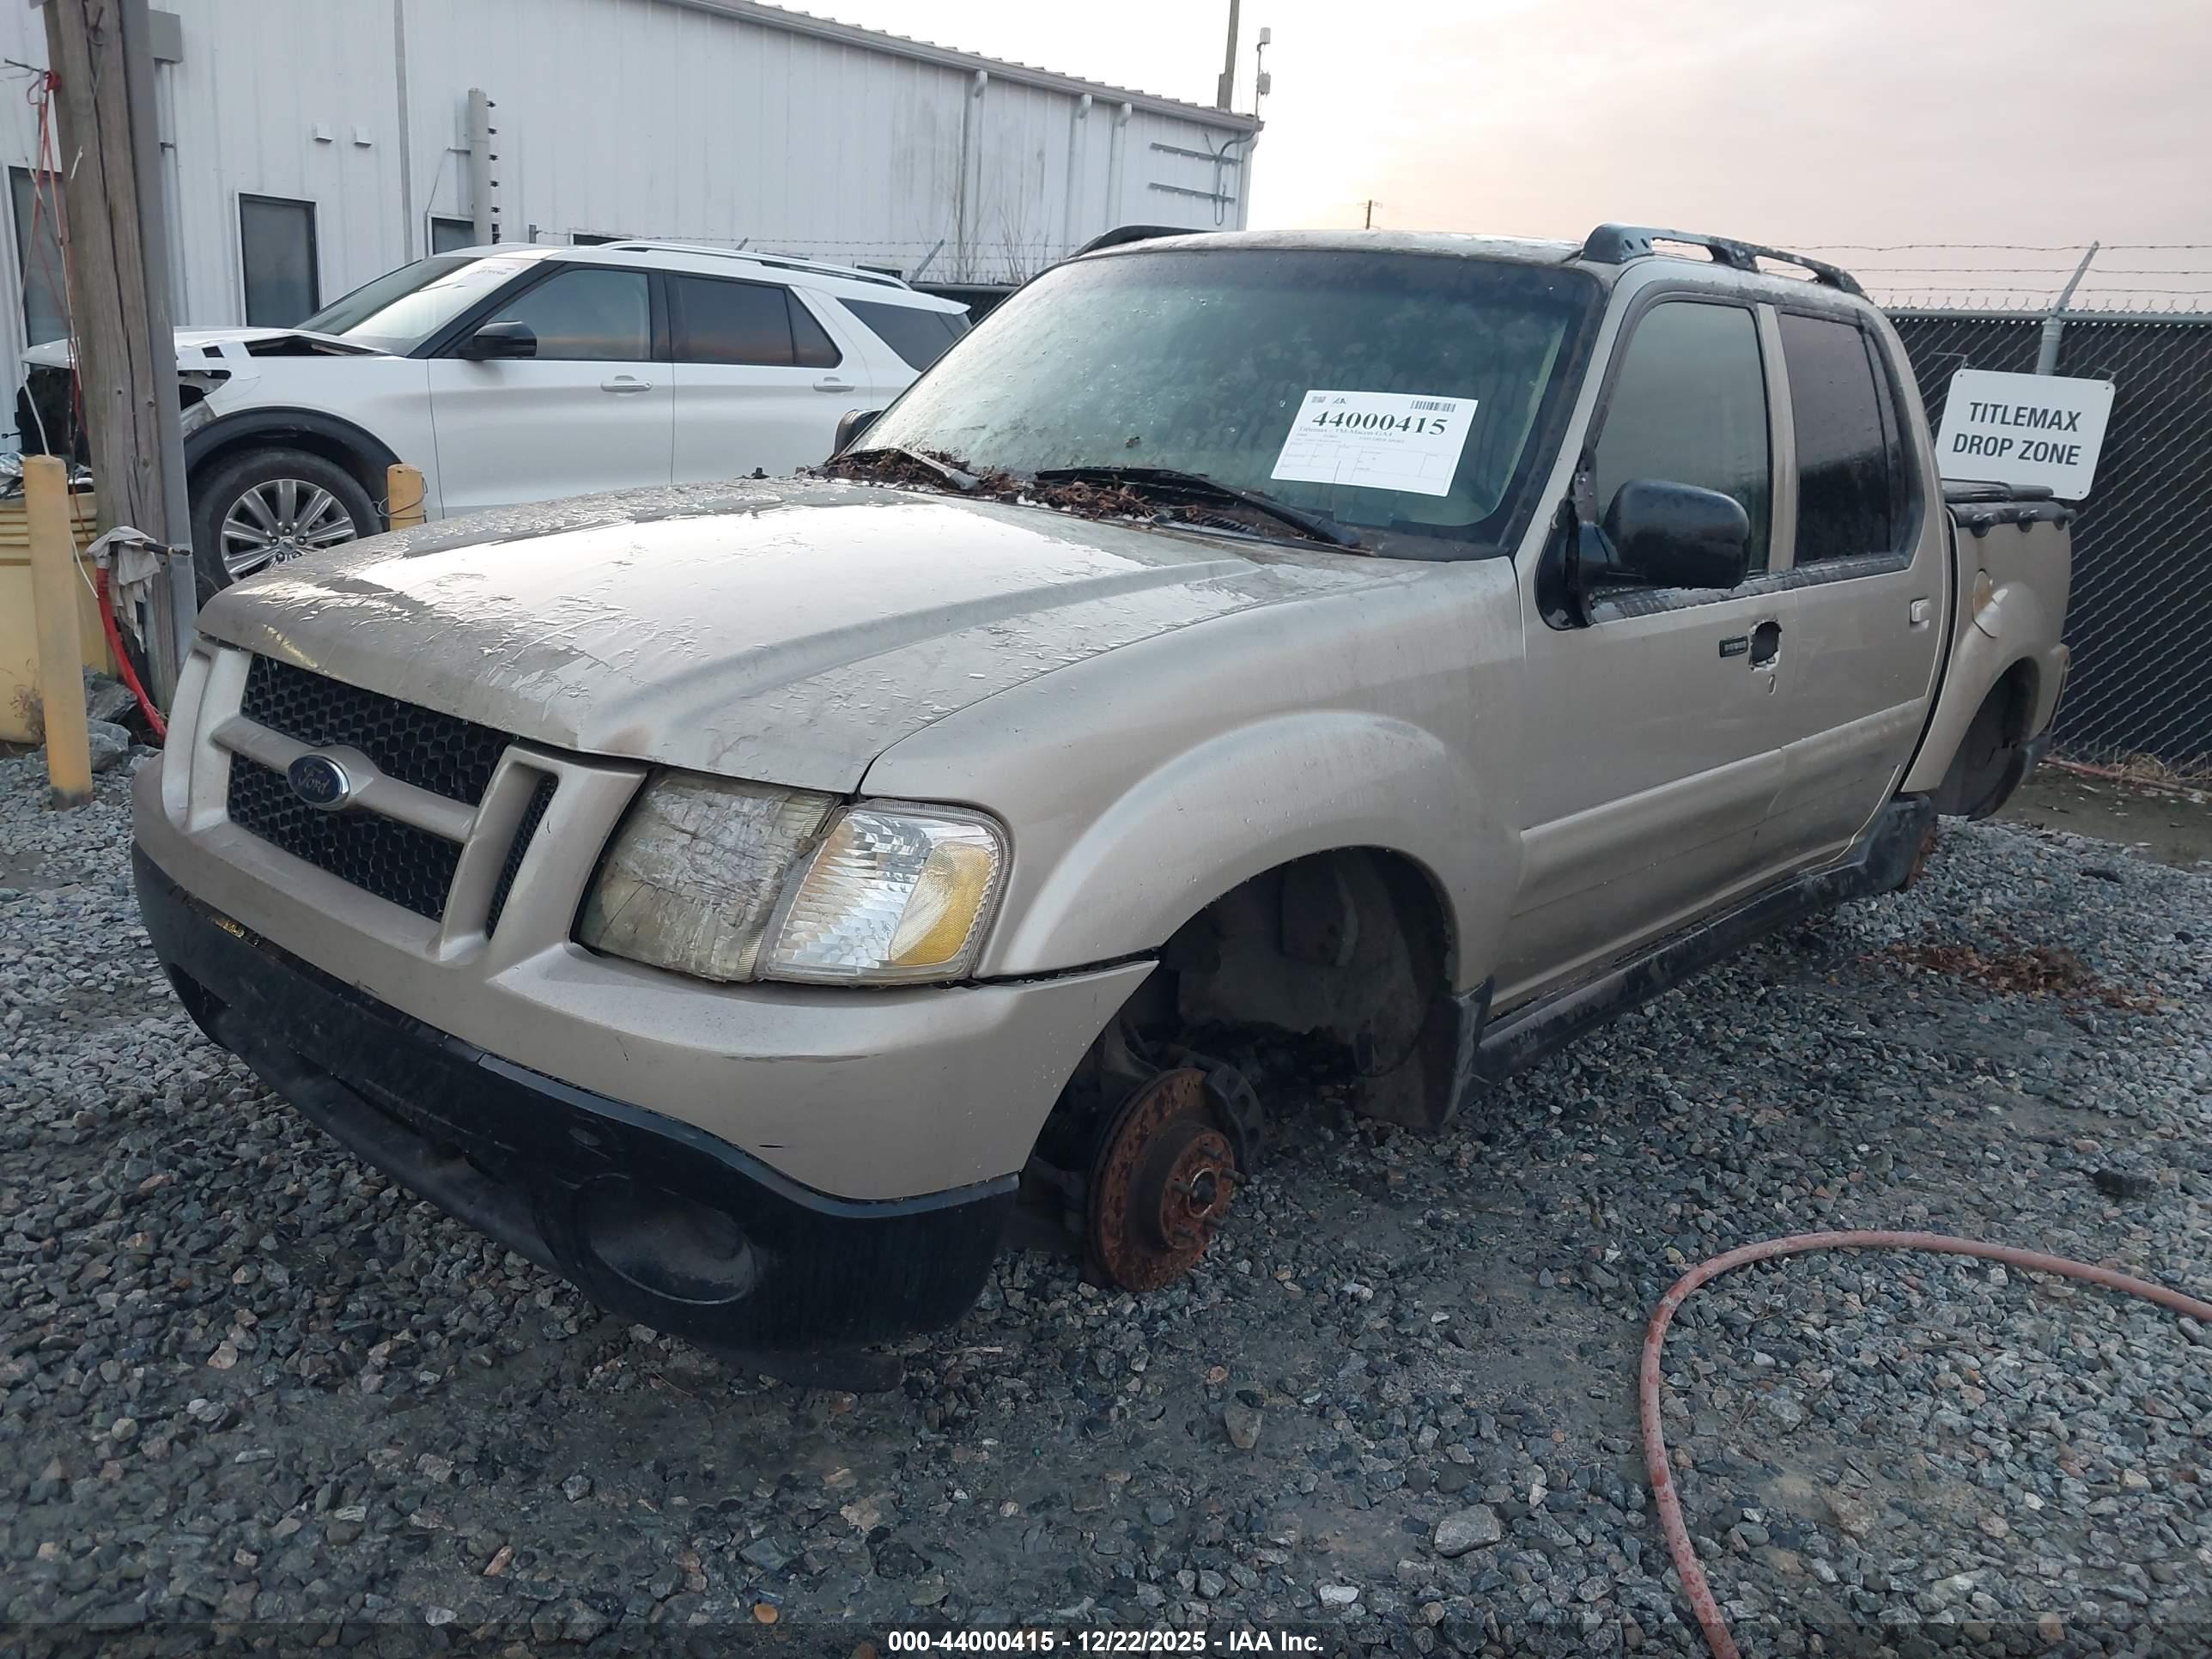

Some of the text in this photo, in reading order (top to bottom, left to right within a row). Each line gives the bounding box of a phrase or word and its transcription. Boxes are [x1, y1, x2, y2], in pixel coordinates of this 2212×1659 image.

[1312, 410, 1449, 435] 44000415
[1969, 401, 2082, 432] TITLEMAX
[1953, 433, 2082, 465] DROP ZONE
[297, 763, 331, 796] Ford
